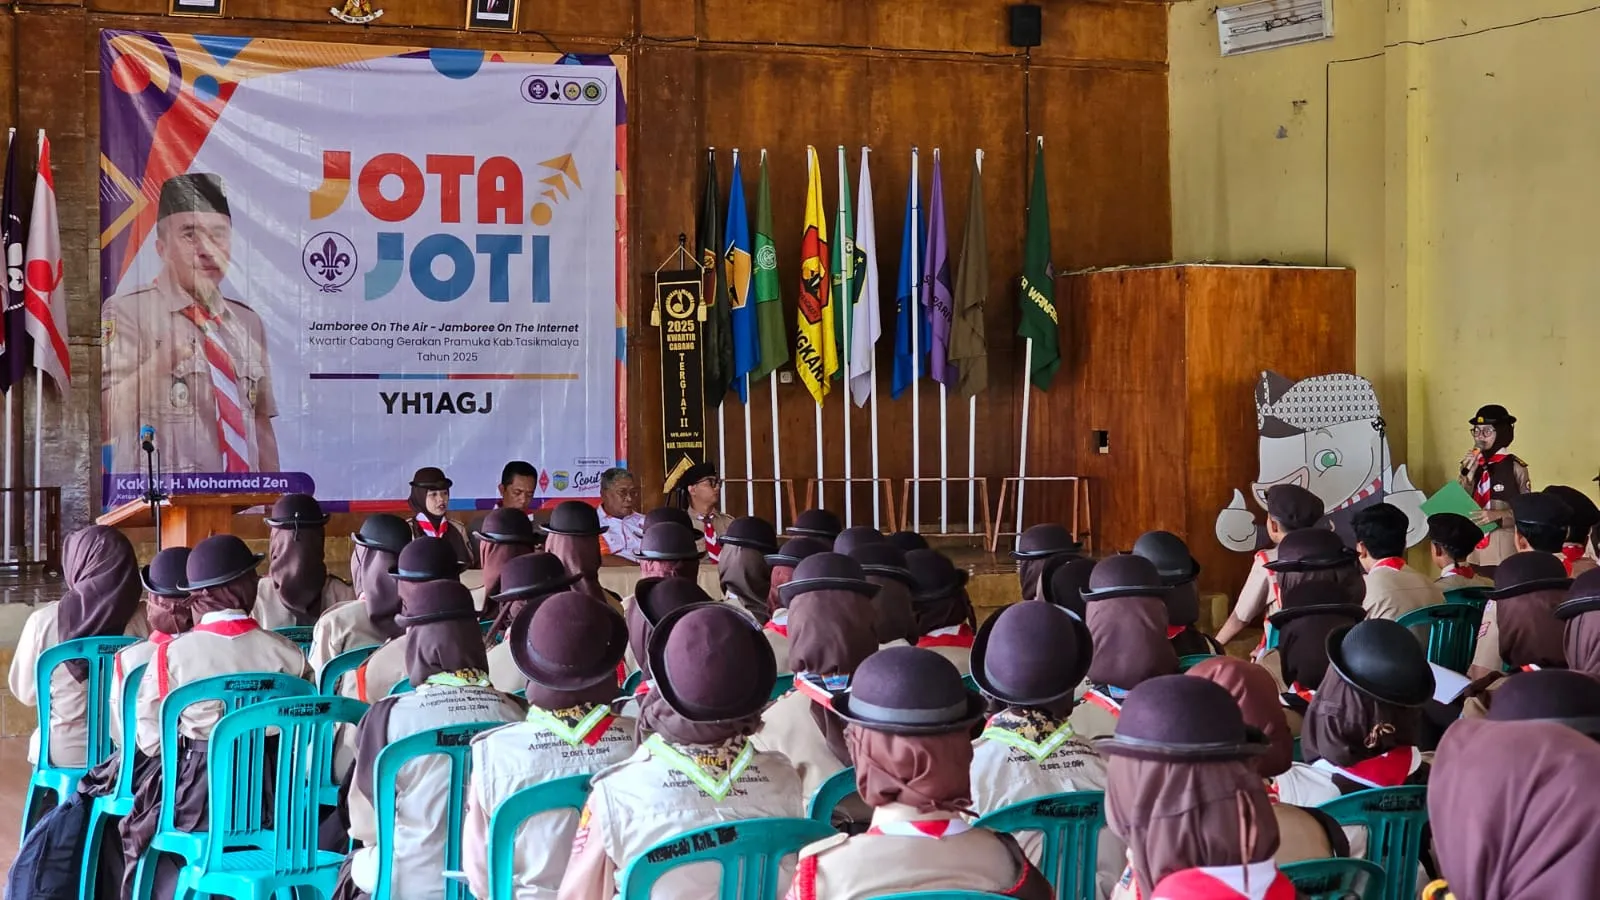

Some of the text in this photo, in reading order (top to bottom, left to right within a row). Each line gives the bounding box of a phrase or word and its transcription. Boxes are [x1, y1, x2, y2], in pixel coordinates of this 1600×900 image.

[309, 150, 524, 225] JOTA
[309, 322, 369, 333] Jamboree
[370, 322, 387, 332] On
[389, 322, 410, 332] The
[412, 322, 429, 332] Air
[438, 322, 495, 333] Jamboree
[497, 323, 512, 333] On
[515, 323, 534, 333] The
[536, 323, 579, 333] Internet
[667, 320, 695, 333] 2025
[309, 335, 346, 346] Kwartir
[349, 335, 394, 348] Cabang
[396, 335, 441, 346] Gerakan
[444, 336, 491, 347] Pramuka
[669, 342, 695, 351] CABANG
[417, 352, 478, 362] Tahun 2025
[379, 391, 493, 415] YH1AGJ
[116, 478, 145, 490] Kak
[171, 478, 185, 489] H.
[187, 477, 261, 489] Mohamad
[262, 477, 289, 488] Zen
